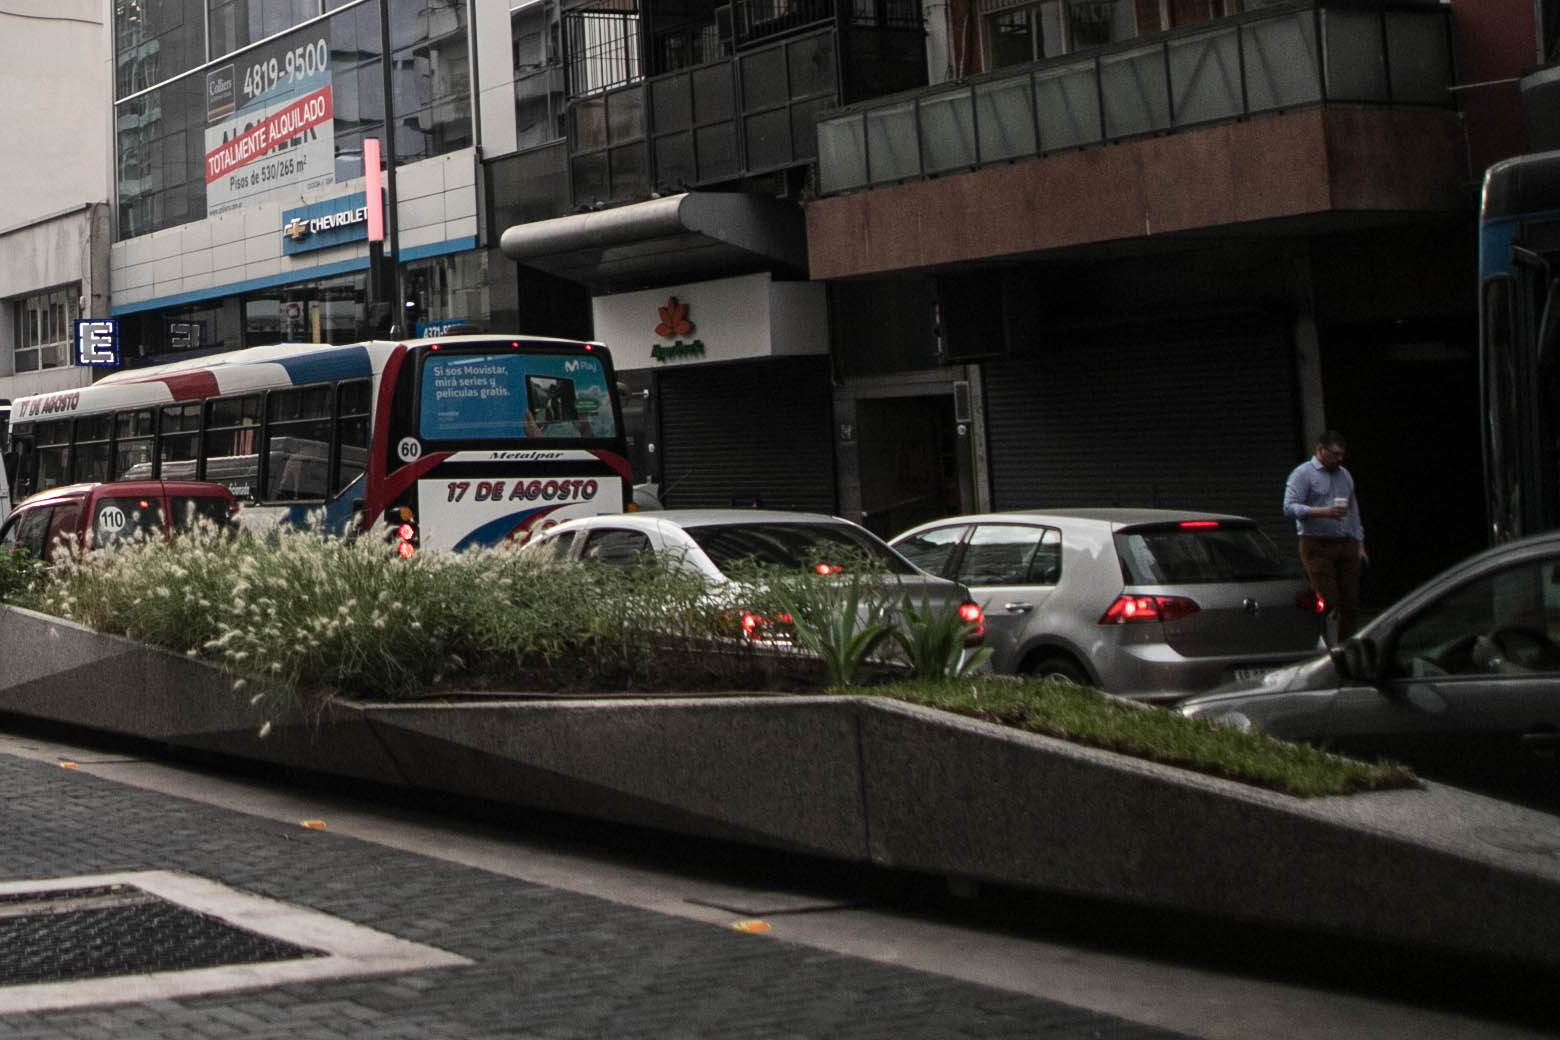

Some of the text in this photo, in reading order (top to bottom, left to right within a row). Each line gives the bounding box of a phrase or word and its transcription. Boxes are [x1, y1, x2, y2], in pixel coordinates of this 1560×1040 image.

[243, 39, 328, 98] 4819-9500
[208, 127, 267, 177] TOTALMENTE
[269, 96, 326, 143] ALQUILADO
[230, 176, 249, 191] Pisos
[251, 169, 260, 183] de
[261, 158, 294, 182] 530/265
[310, 206, 368, 233] CHEVROLET
[79, 321, 114, 363] E
[445, 368, 463, 376] sos
[459, 376, 488, 387] series
[489, 378, 497, 388] y
[41, 391, 80, 414] AGOSTO
[400, 442, 418, 458] 60
[489, 450, 565, 461] Metalpar
[447, 479, 599, 503] 17 DE AGOSTO
[100, 513, 123, 528] 110
